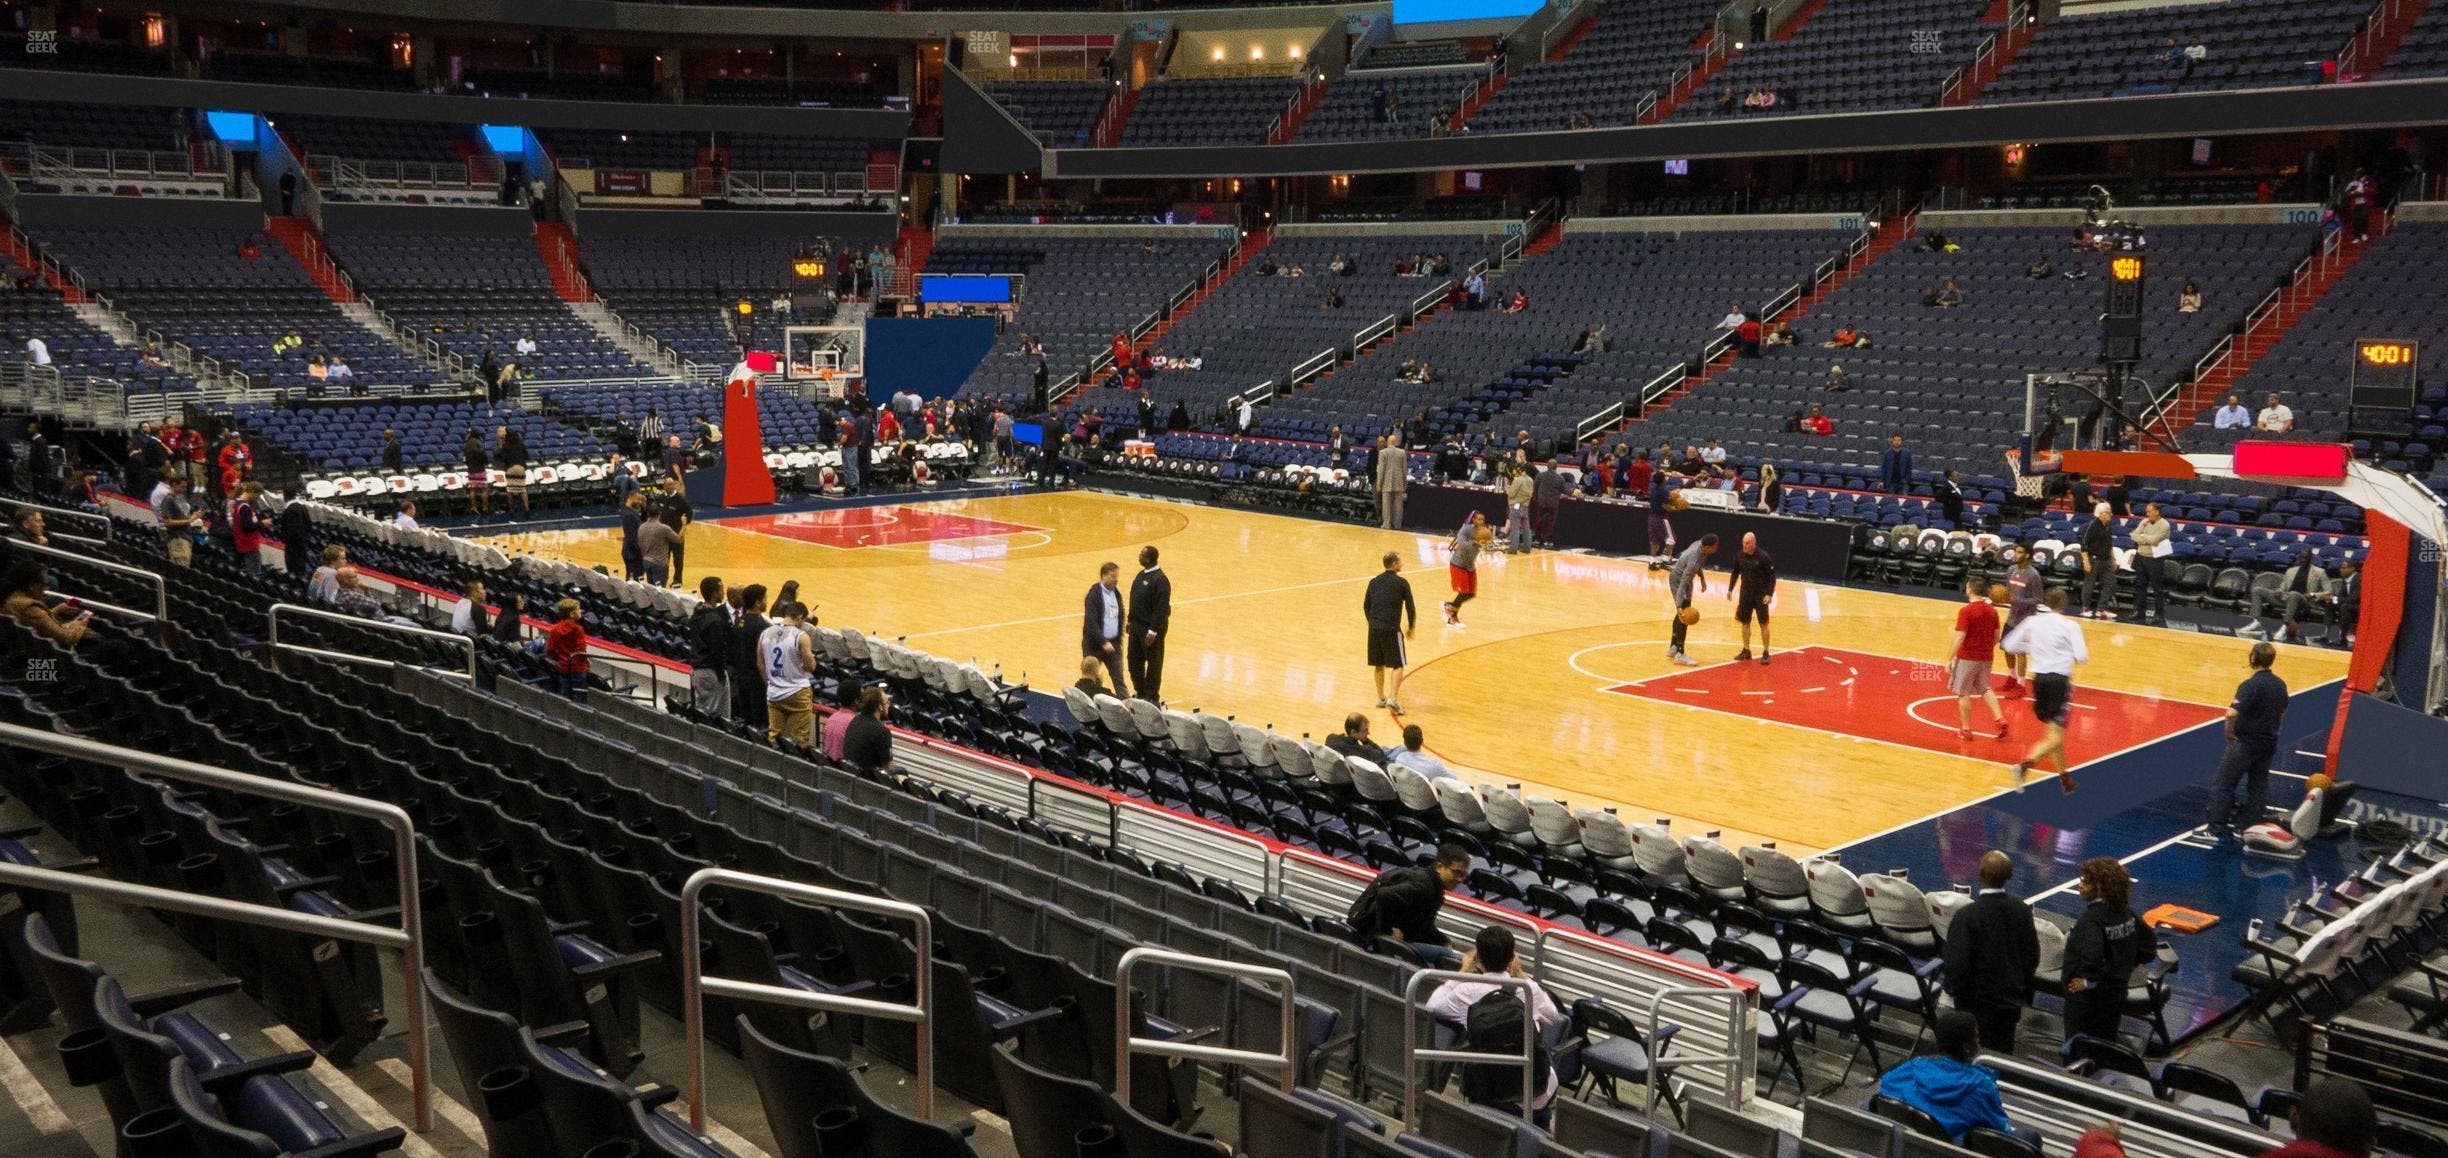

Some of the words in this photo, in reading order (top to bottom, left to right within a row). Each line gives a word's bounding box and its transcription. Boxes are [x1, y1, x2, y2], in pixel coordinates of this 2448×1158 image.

[2288, 210, 2318, 223] 100
[1506, 223, 1521, 236] 102
[1840, 218, 1858, 230] 101
[2363, 345, 2411, 364] 40:01
[772, 646, 783, 668] 2
